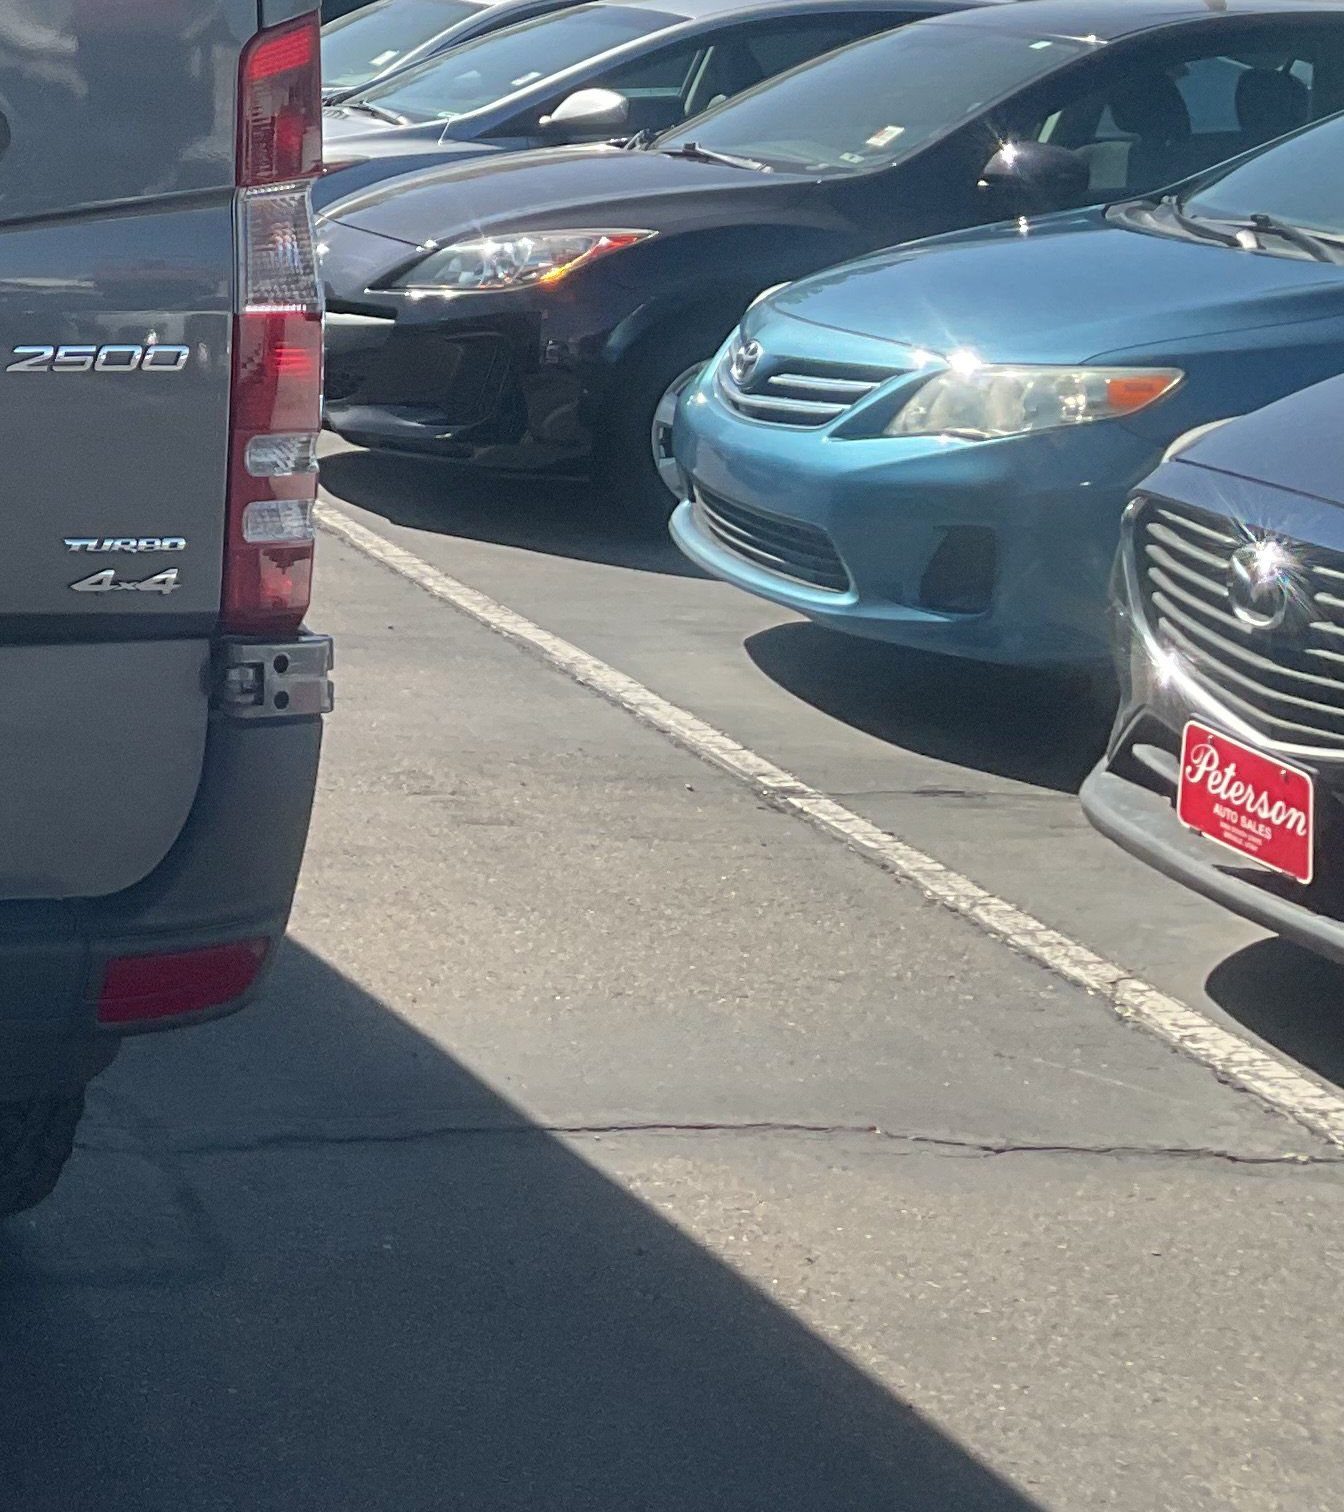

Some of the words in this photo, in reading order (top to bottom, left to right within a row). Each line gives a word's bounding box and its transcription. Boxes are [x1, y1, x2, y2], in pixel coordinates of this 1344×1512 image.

[6, 345, 190, 372] 2500
[64, 537, 187, 553] TURBO
[69, 568, 183, 594] 4x4
[1185, 743, 1307, 837] Peterson
[1213, 802, 1239, 824] AUTO
[1240, 815, 1273, 840] SALES
